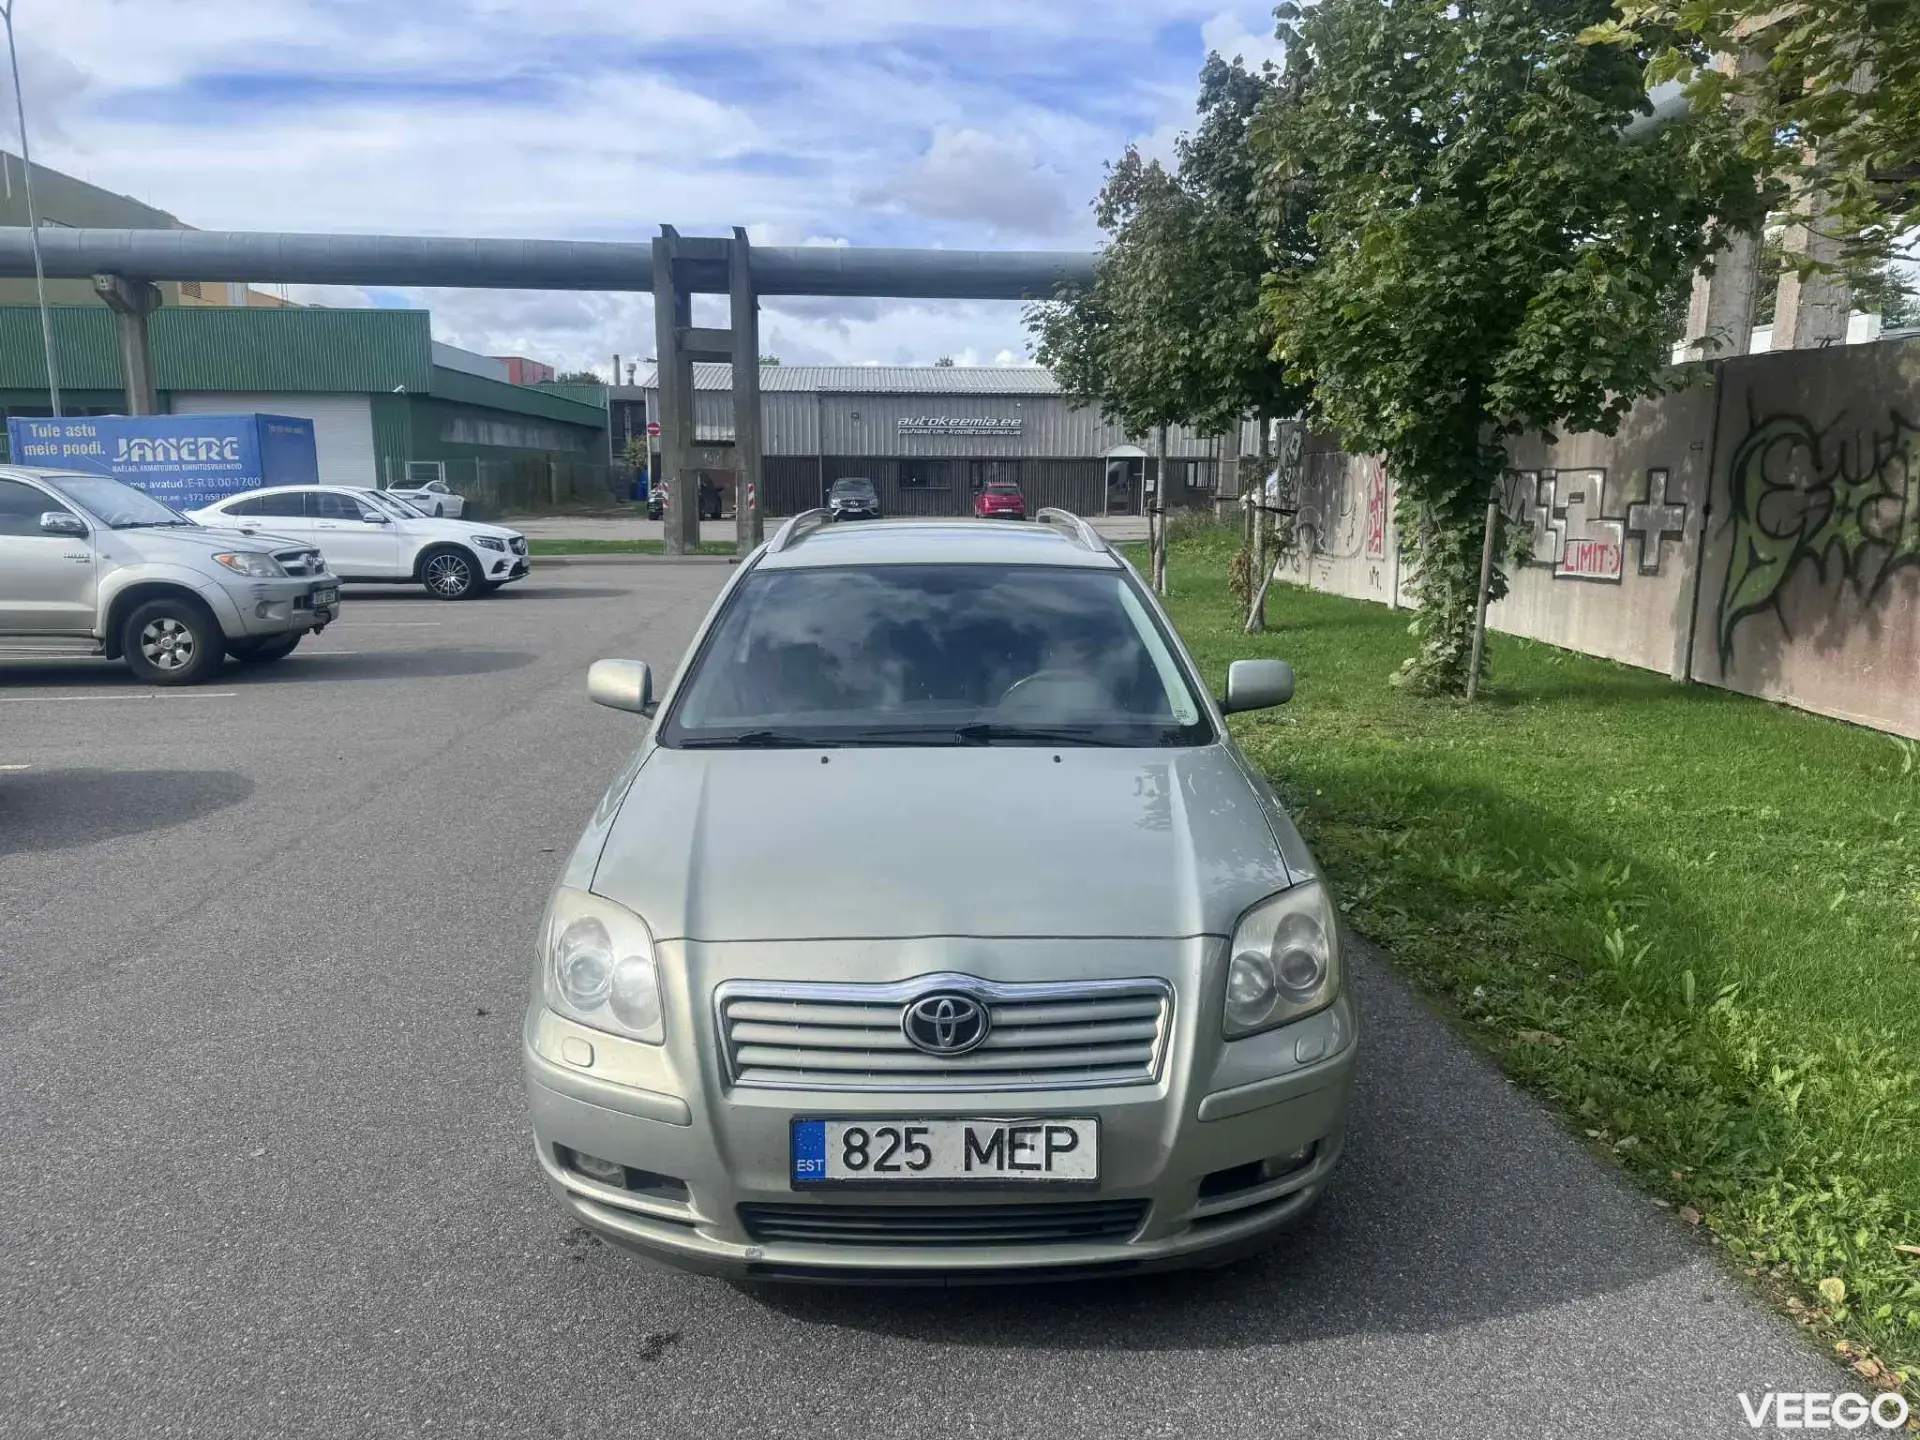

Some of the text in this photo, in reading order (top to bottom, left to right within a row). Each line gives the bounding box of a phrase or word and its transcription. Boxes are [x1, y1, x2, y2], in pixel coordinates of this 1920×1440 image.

[898, 415, 1021, 426] autokeemia.ee
[30, 424, 96, 437] Tule astu
[24, 441, 106, 457] meie poodi.
[112, 437, 240, 462] JANERE
[796, 1125, 1079, 1172] EST 825 MEP
